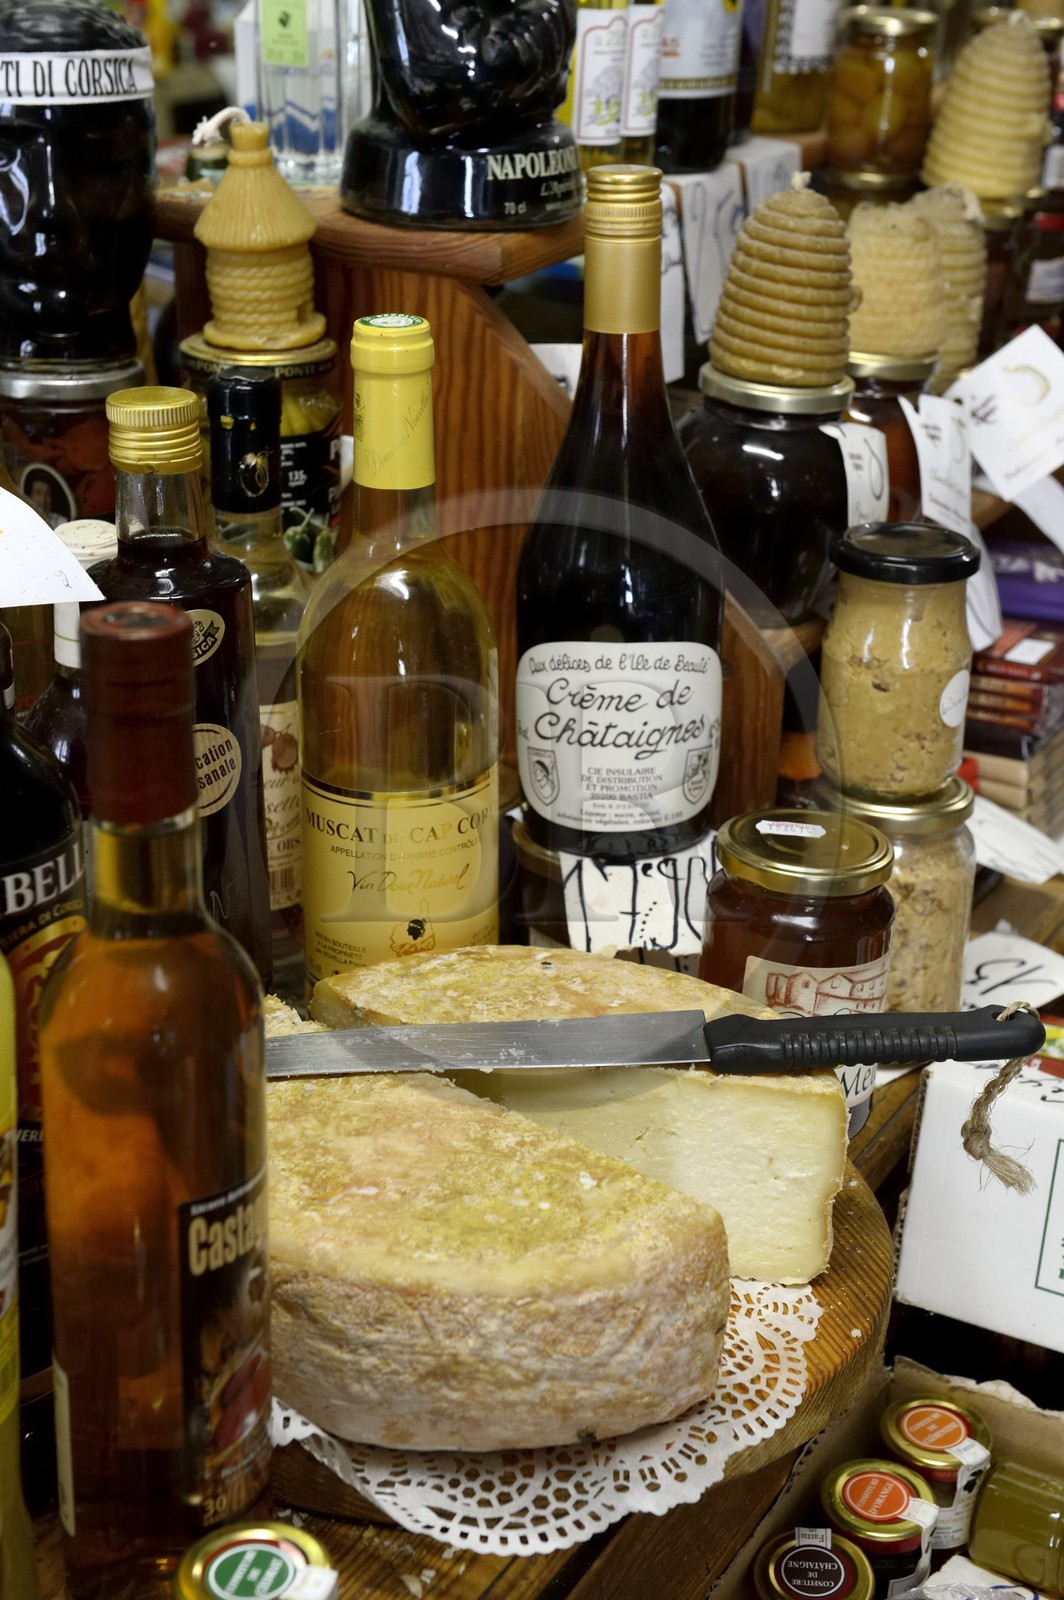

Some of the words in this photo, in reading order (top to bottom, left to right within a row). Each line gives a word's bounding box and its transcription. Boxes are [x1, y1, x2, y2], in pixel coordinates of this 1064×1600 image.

[33, 60, 55, 97] DI
[65, 58, 138, 96] CORSICA
[274, 366, 315, 378] PONTI
[595, 654, 613, 670] de
[653, 654, 671, 670] de
[547, 677, 648, 712] Crème
[656, 679, 695, 709] de
[534, 712, 706, 761] Châtaignes
[596, 774, 663, 784] DISTRIBUTION
[600, 784, 658, 793] PROMOTION
[619, 792, 654, 801] BASTIA
[305, 807, 378, 844] MUSCAT
[410, 822, 454, 844] CAP
[330, 845, 387, 861] APPELLATION
[347, 870, 379, 892] Vin
[332, 939, 367, 954] BOUTEILLE
[323, 952, 348, 965] NOVELLA
[868, 1480, 895, 1516] D'ORANGE
[787, 1560, 839, 1571] CHÂTAIGNE
[791, 1578, 835, 1587] CONFITURE
